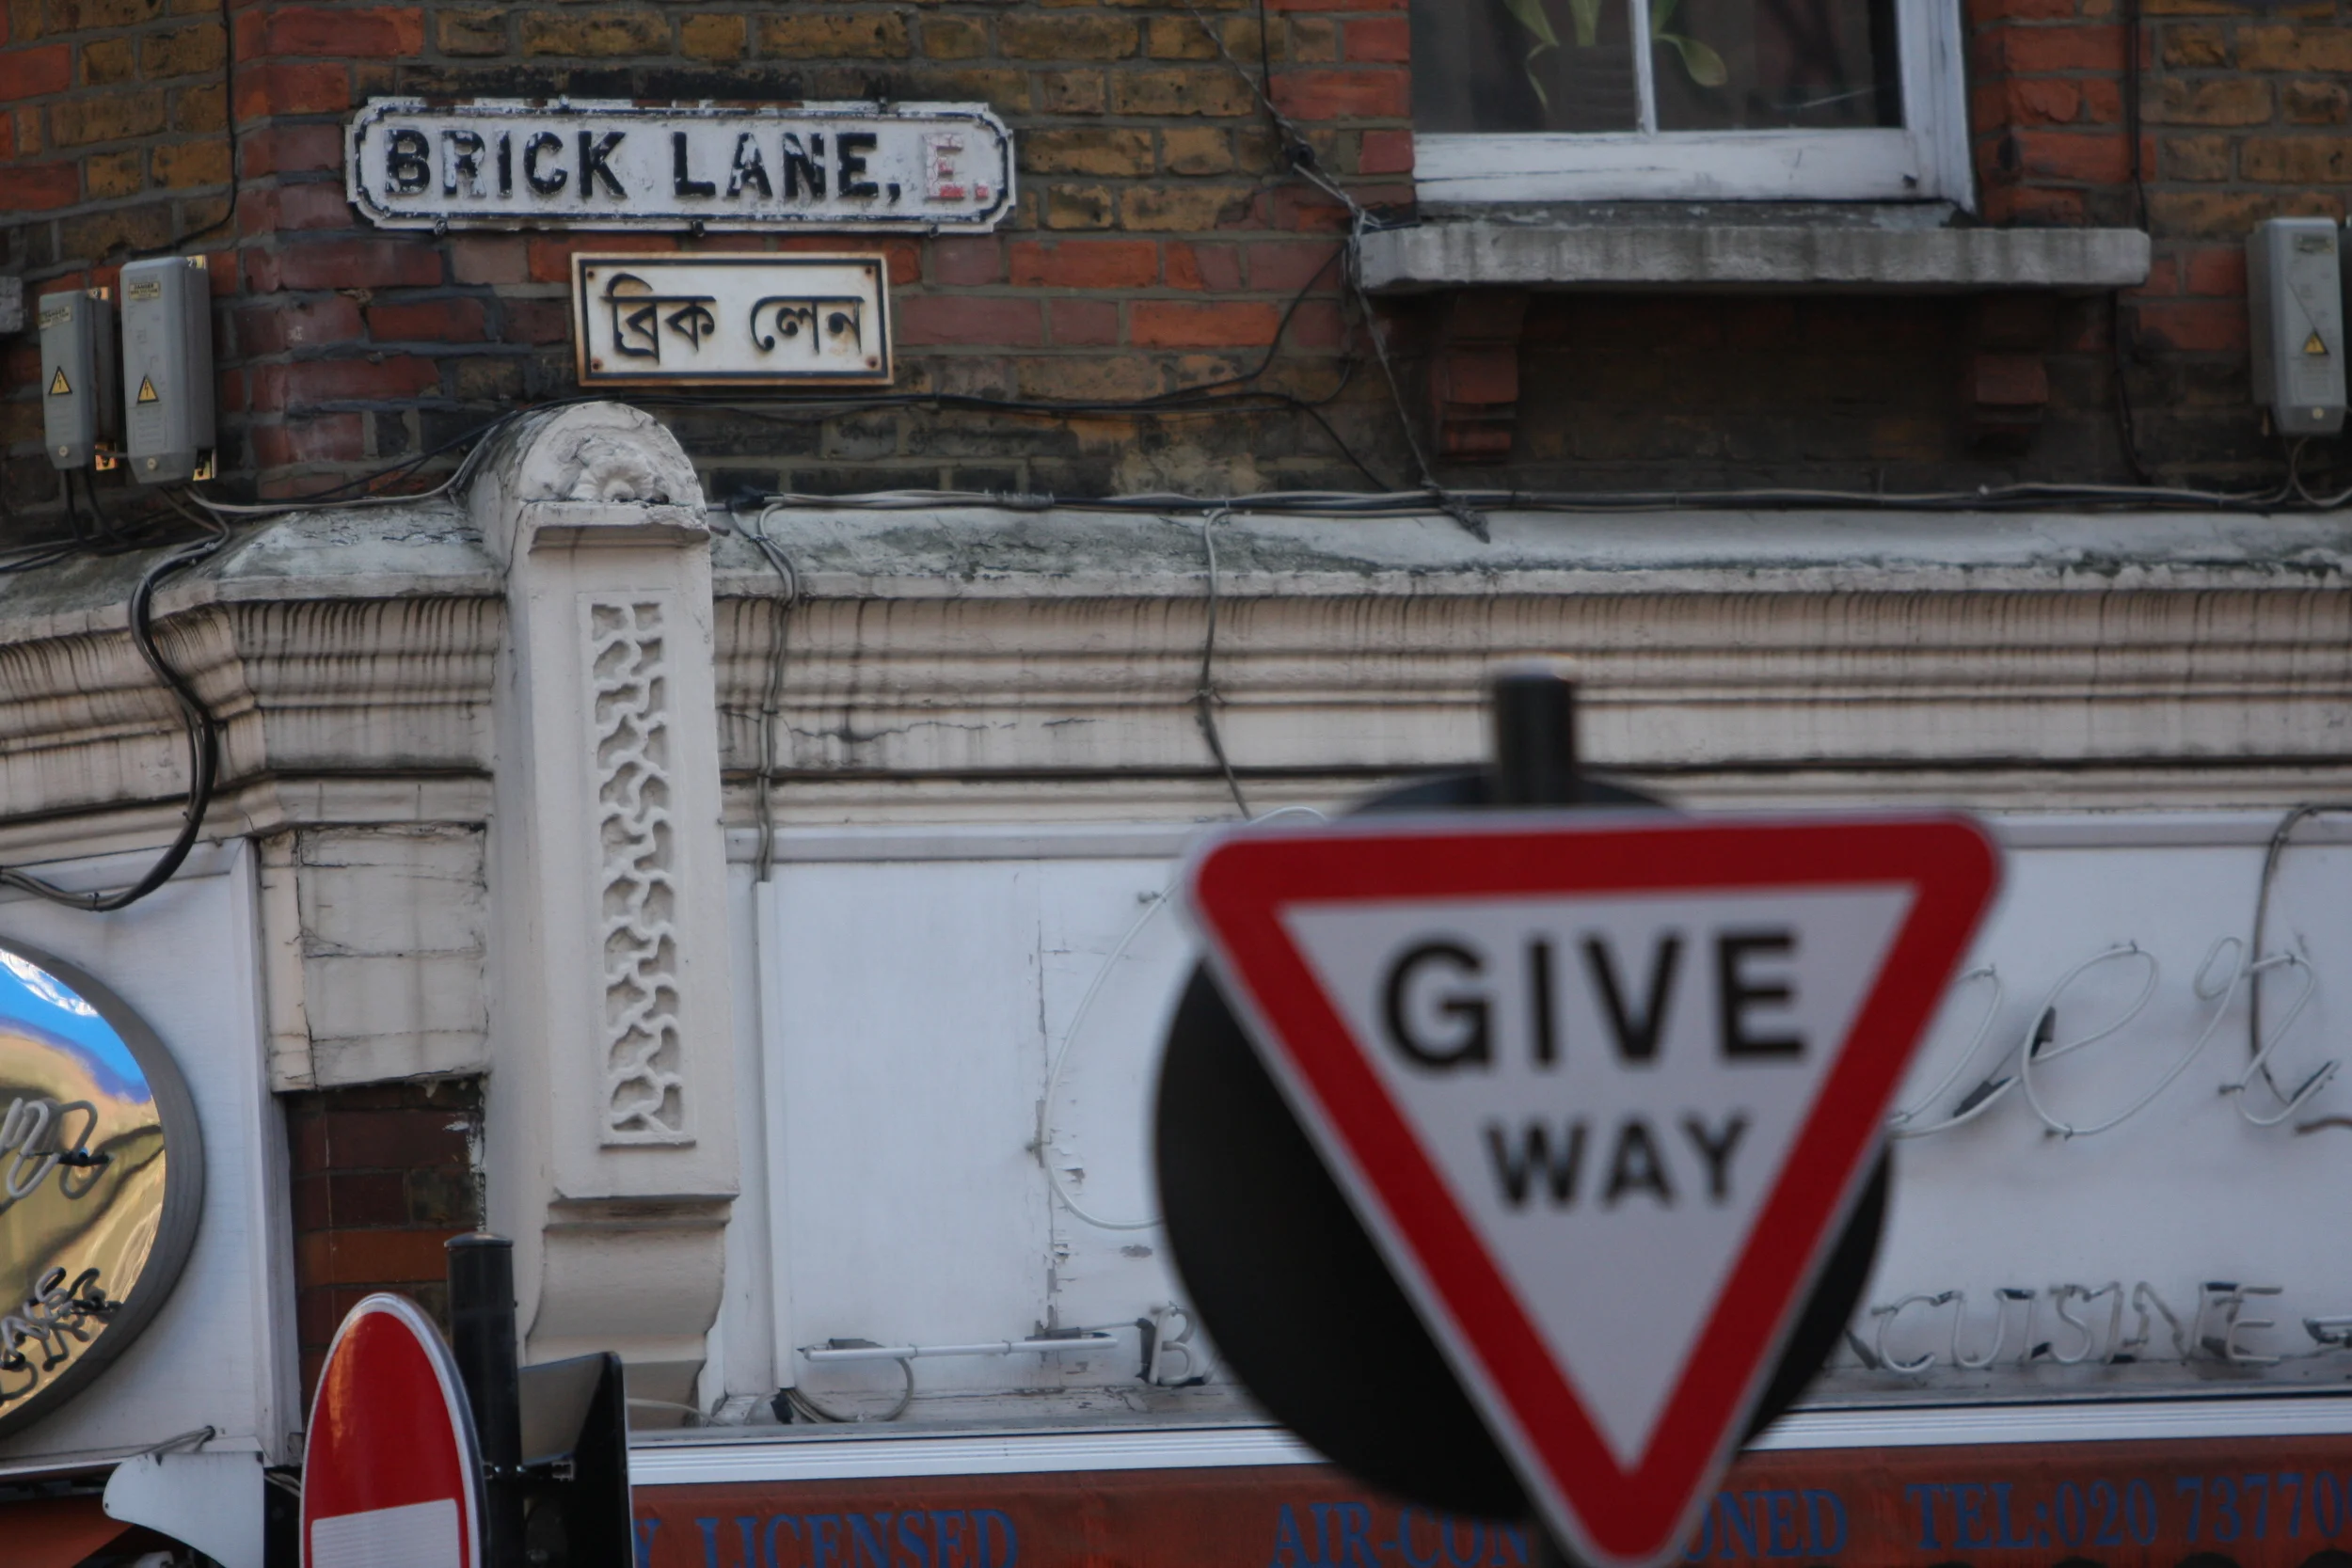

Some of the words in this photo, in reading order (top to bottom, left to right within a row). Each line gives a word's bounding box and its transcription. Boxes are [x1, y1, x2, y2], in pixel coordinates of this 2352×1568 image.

[385, 129, 628, 199] BRICK
[671, 131, 902, 203] LANE,
[921, 132, 989, 201] E.
[599, 272, 717, 365] ব্রিক
[749, 294, 865, 355] লেন
[1380, 926, 1807, 1075] GIVE
[1485, 1110, 1751, 1212] WAY
[1876, 1280, 2284, 1374] CUISINE
[694, 1509, 1019, 1568] LICENSED
[1905, 1478, 2158, 1552] TEL:020
[2176, 1470, 2352, 1545] 73770
